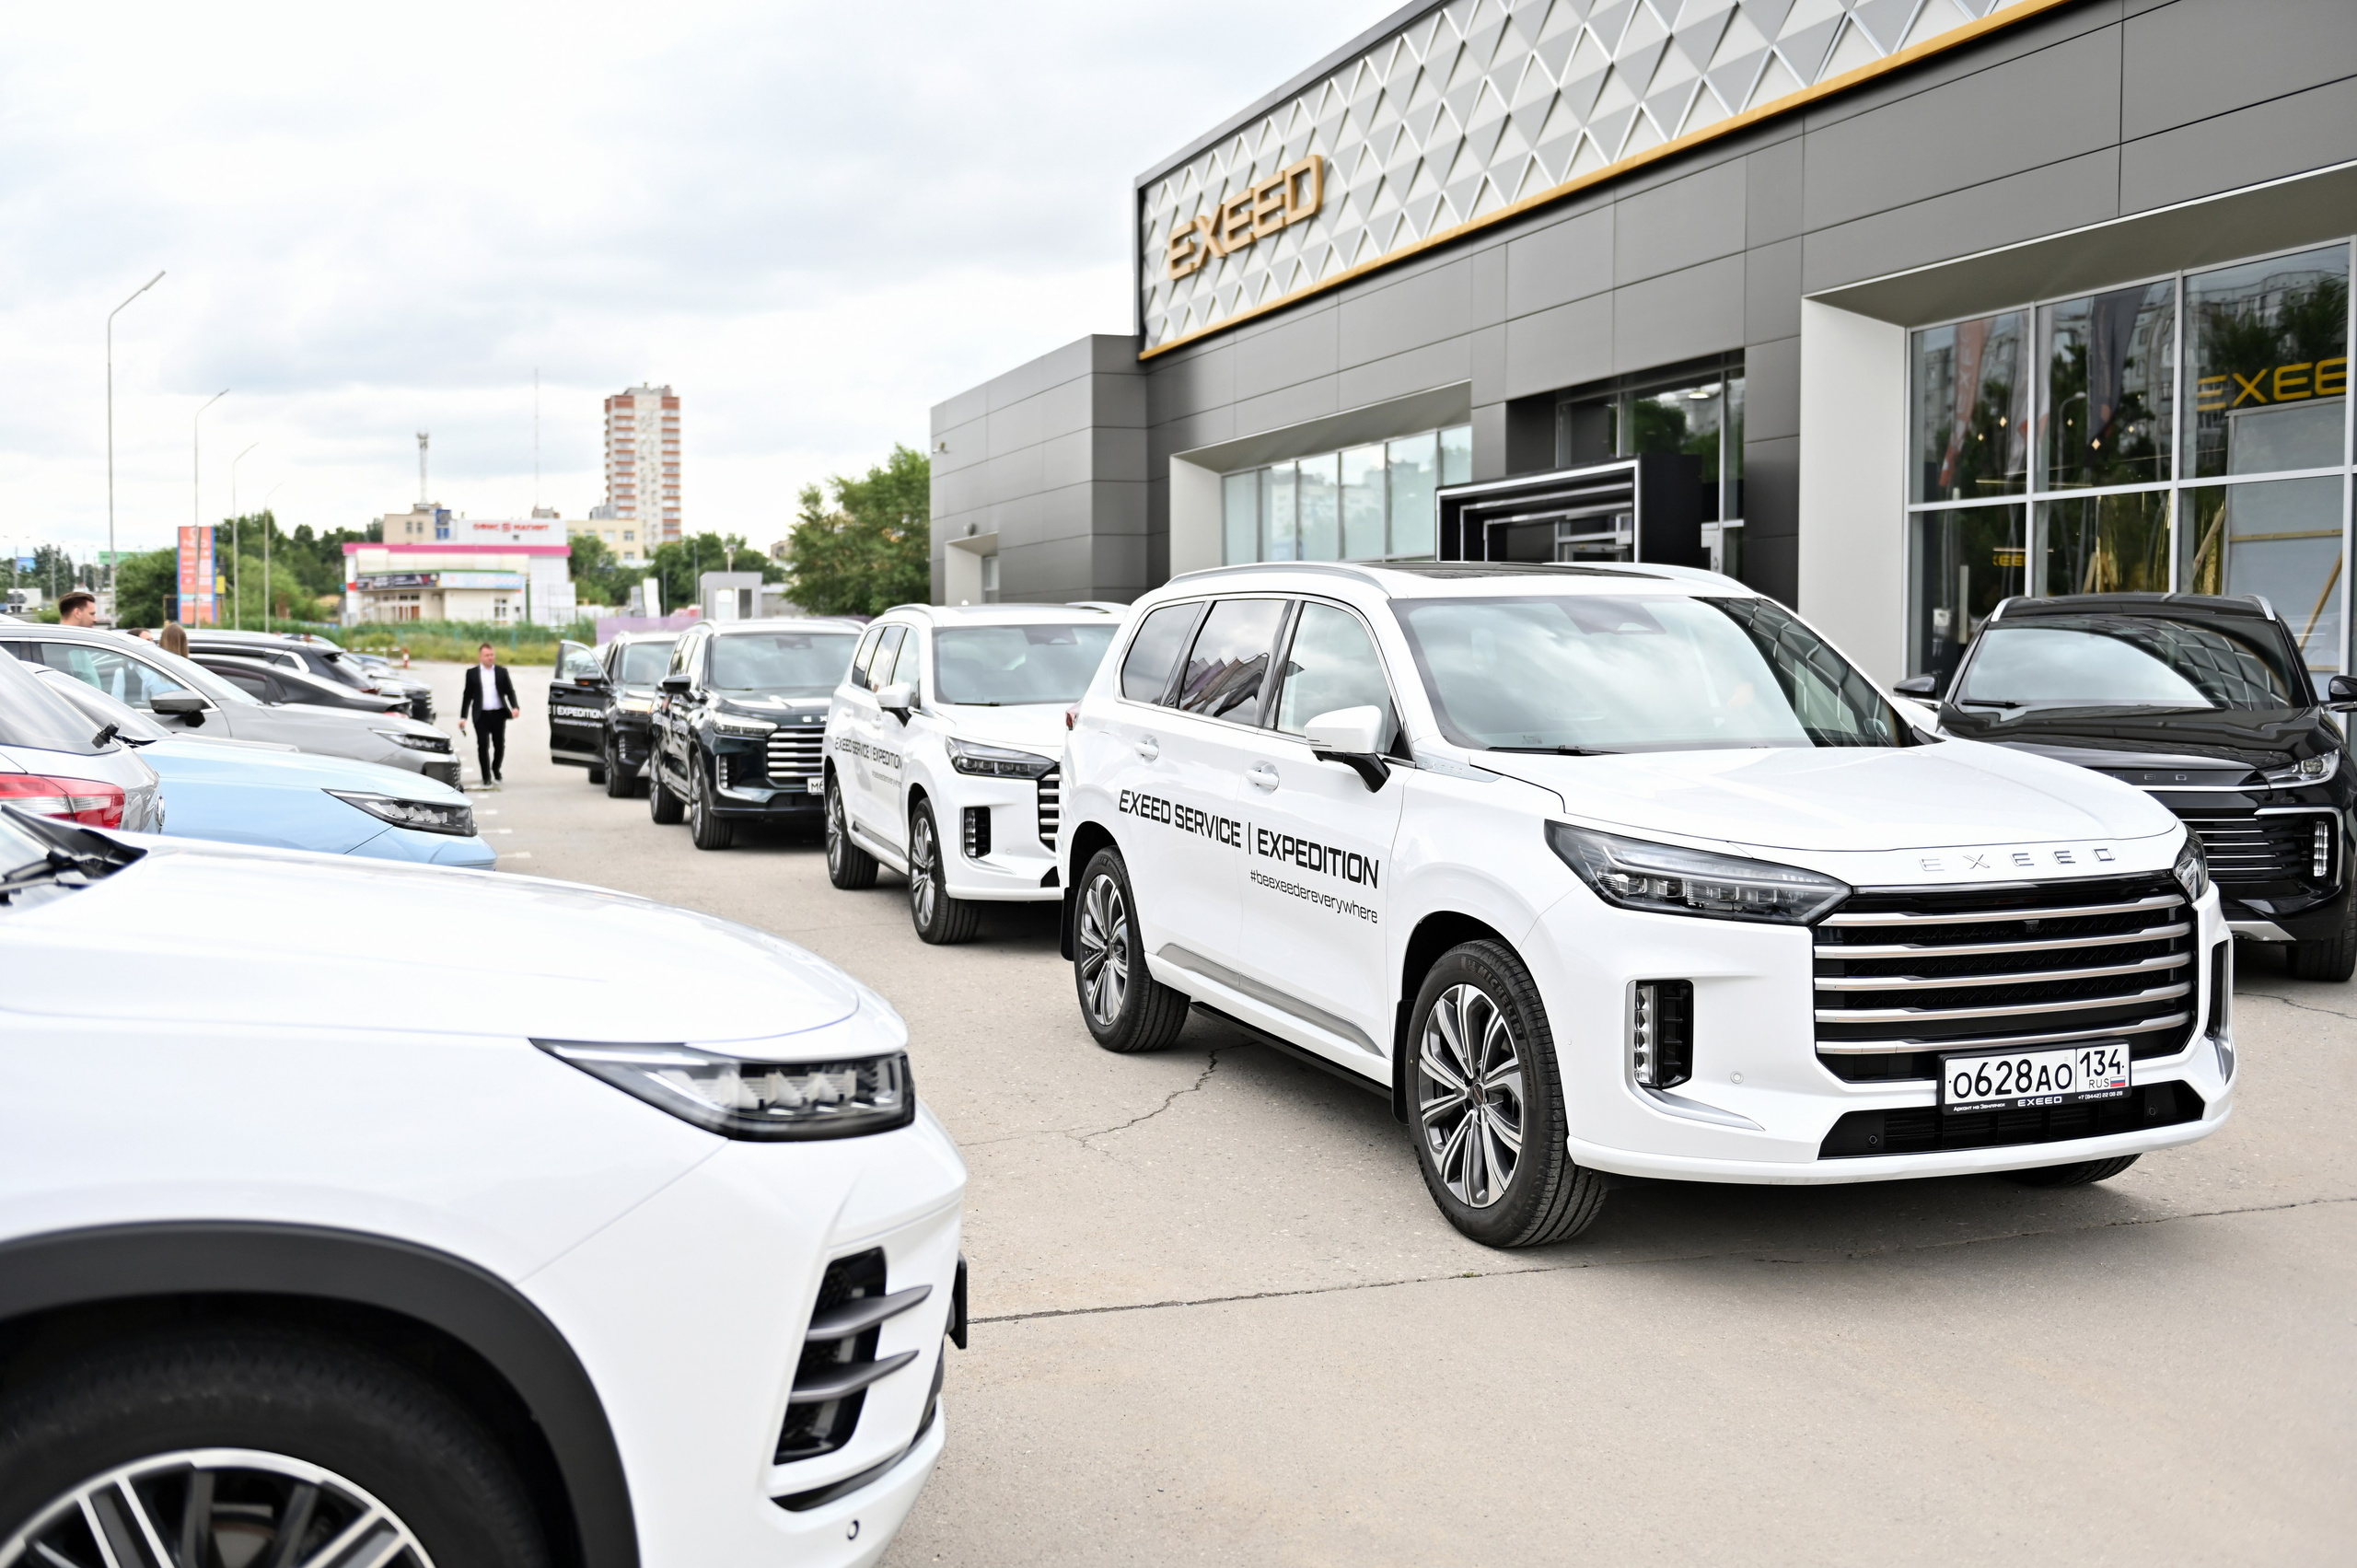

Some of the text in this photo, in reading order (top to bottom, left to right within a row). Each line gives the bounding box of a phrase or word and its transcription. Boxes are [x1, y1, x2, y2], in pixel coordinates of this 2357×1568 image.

[1167, 154, 1324, 281] EXEED
[557, 705, 605, 718] EXPEDITION
[835, 737, 852, 752] EXEED
[873, 747, 902, 771] EXPEDITION
[1119, 789, 1171, 825] EXEED
[1175, 804, 1242, 848] SERVICE
[1258, 828, 1379, 889] EXPEDITION
[1919, 848, 2116, 871] EXEED
[1249, 869, 1378, 924] #beexeedereverywhere
[1477, 966, 1522, 1035] MICHELIN
[2079, 1049, 2121, 1077] 134
[2088, 1077, 2109, 1089] RUS
[2017, 1096, 2062, 1107] EXEED
